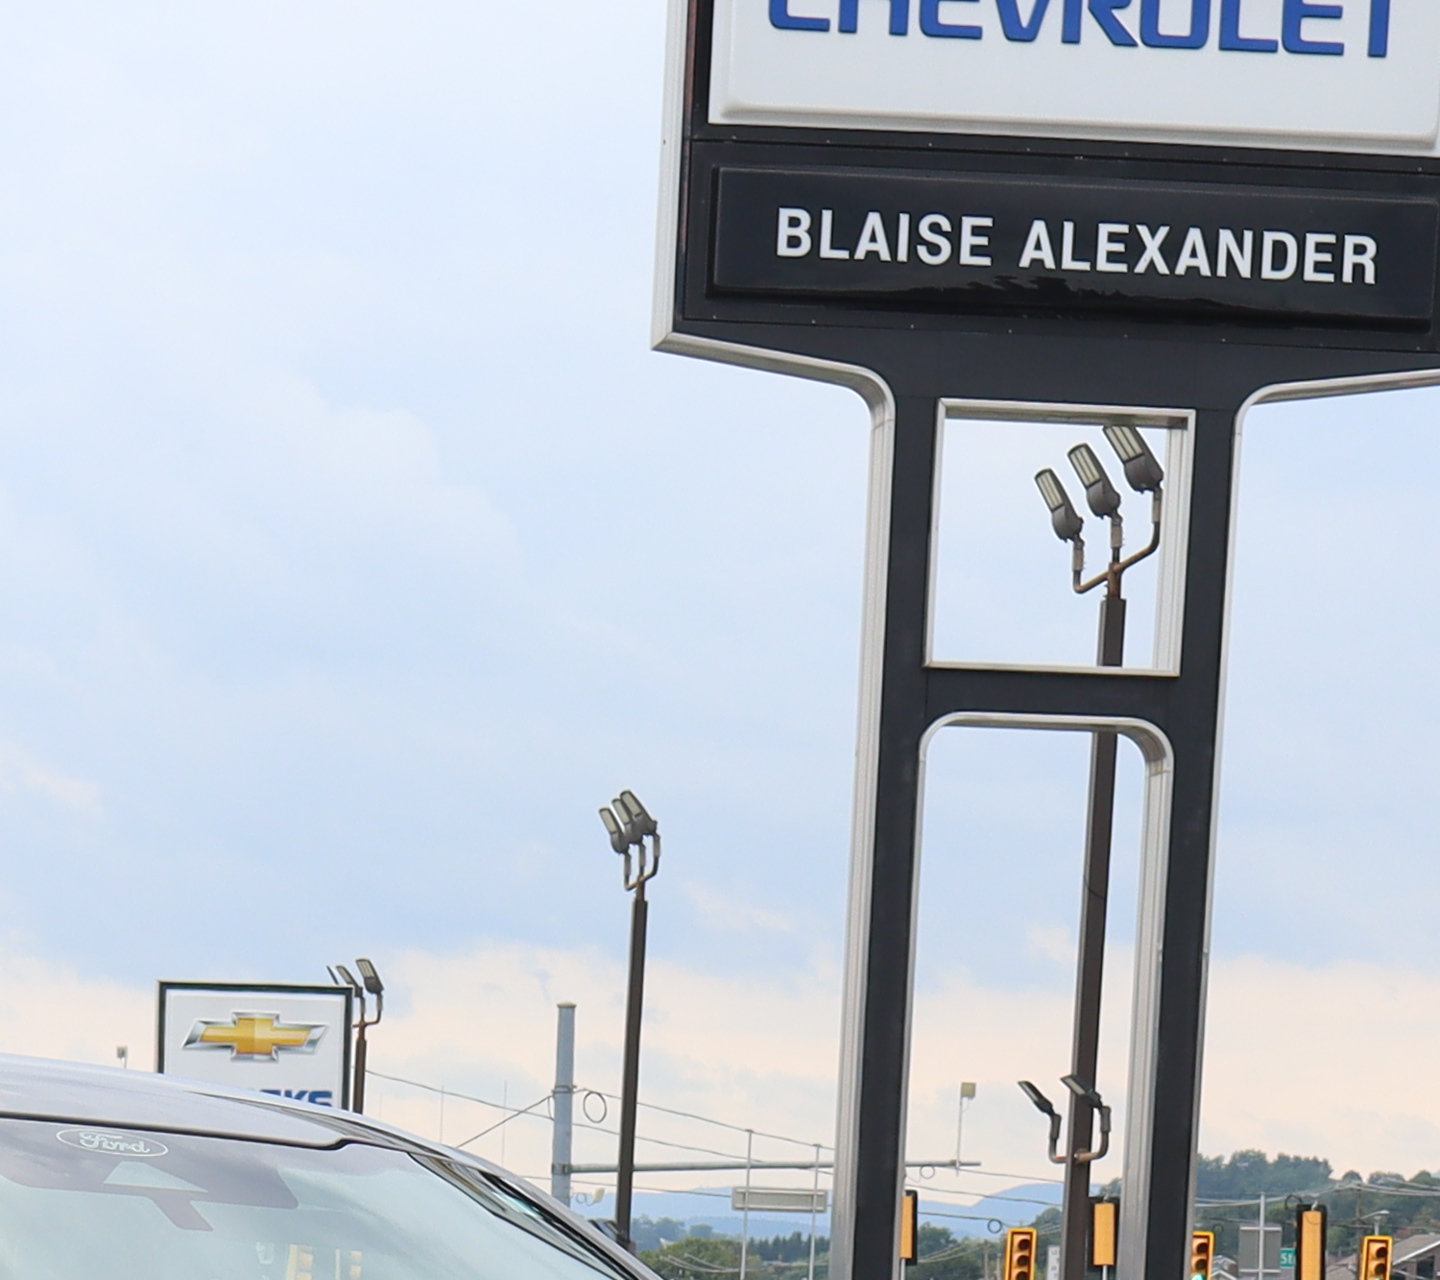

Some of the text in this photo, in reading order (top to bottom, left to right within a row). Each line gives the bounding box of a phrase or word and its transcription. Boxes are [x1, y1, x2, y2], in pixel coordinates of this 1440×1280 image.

[776, 206, 1378, 285] BLAISE ALEXANDER
[79, 1131, 151, 1153] Ford
